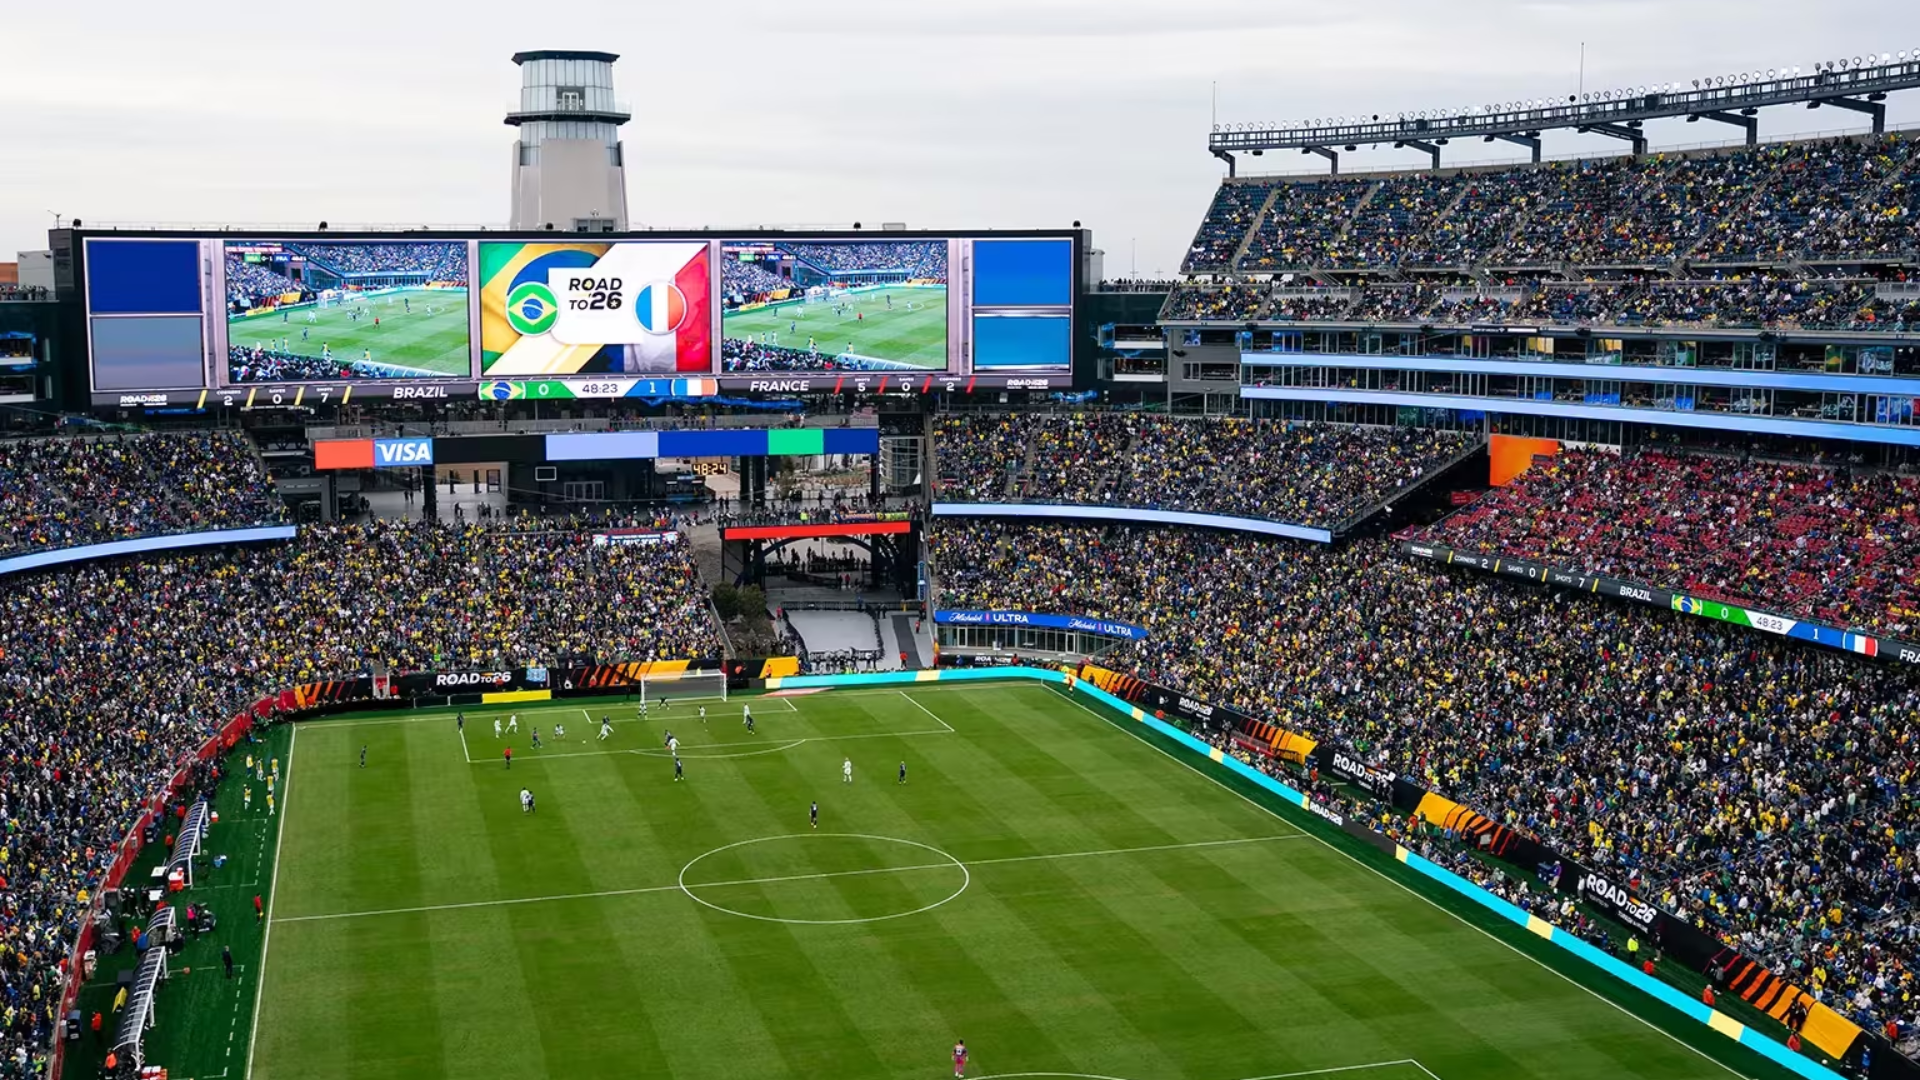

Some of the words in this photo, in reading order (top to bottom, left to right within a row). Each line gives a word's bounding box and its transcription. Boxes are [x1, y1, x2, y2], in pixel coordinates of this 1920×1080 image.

[568, 277, 623, 291] ROAD
[569, 299, 589, 310] TO
[538, 383, 549, 396] 0
[581, 383, 618, 394] 48:23
[649, 382, 656, 393] 1
[750, 380, 809, 392] FRANCE
[857, 382, 866, 392] 5
[901, 382, 911, 392] 0
[946, 382, 955, 391] 2
[320, 392, 329, 403] 7
[393, 386, 448, 399] BRAZIL
[223, 395, 233, 406] 2
[272, 394, 282, 405] 0
[376, 442, 430, 462] VISA
[693, 463, 728, 475] 48:24
[1481, 558, 1488, 569] 2
[1529, 567, 1536, 578] 0
[1578, 577, 1585, 588] 7
[1619, 585, 1652, 601] BRAZIL
[993, 613, 1029, 624] ULTRA
[1721, 607, 1729, 619] 0
[1756, 616, 1783, 631] 48:23
[1104, 623, 1132, 637] ULTRA
[1813, 628, 1819, 640] 1
[436, 673, 481, 686] ROAD
[1179, 697, 1200, 711] ROAD
[1333, 753, 1366, 777] ROAD
[1309, 800, 1330, 818] ROAD
[1586, 873, 1627, 907] ROAD
[1625, 901, 1637, 914] TO
[1634, 902, 1657, 924] 26
